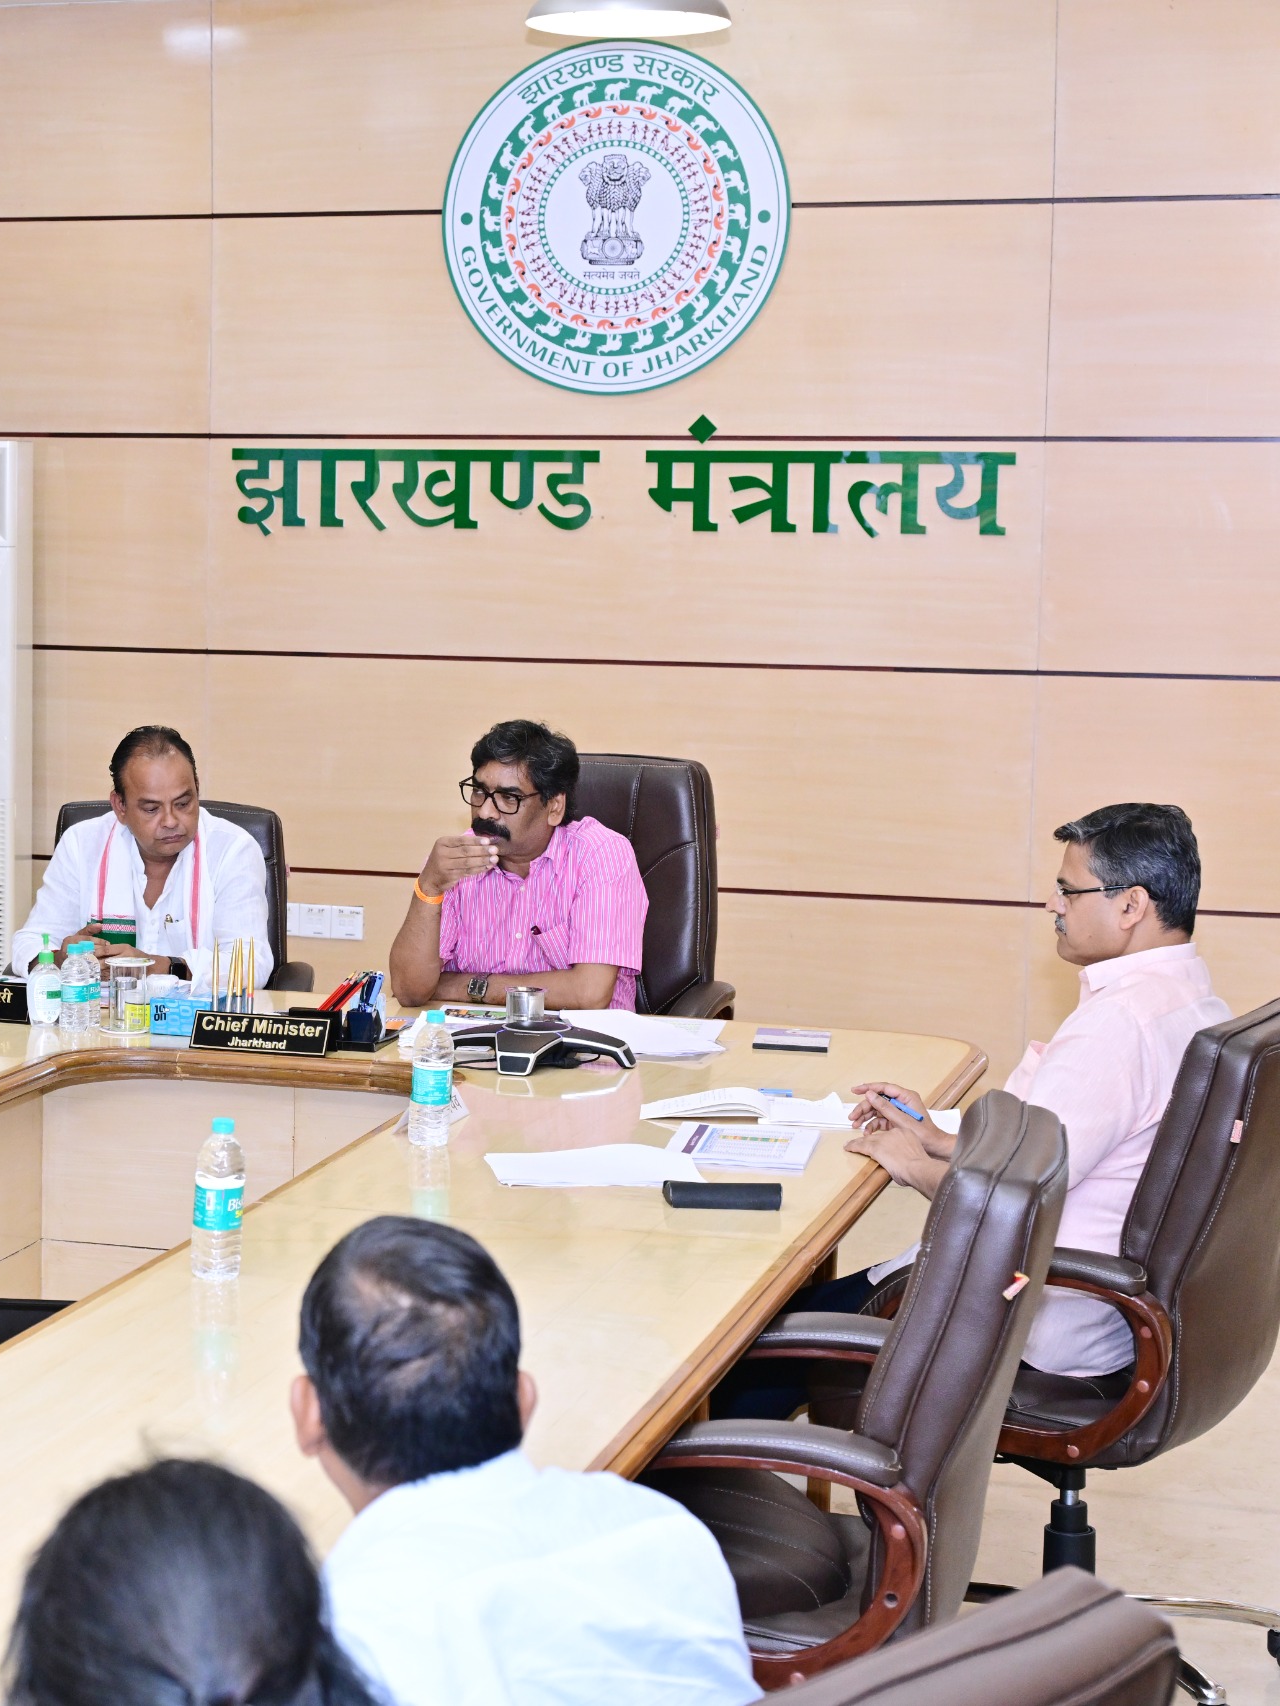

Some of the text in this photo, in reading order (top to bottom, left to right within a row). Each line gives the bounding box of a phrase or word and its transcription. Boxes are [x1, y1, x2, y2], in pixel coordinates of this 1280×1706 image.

[517, 54, 720, 106] झारखण्ड सरकार
[583, 267, 641, 280] सत्यमेव जयते
[461, 244, 768, 378] GOVERNMENT OF JHARKHAND
[231, 413, 1017, 539] झारखण्ड मंत्रालय
[201, 1015, 324, 1038] Chief Minister
[227, 1036, 287, 1050] Jharkhand
